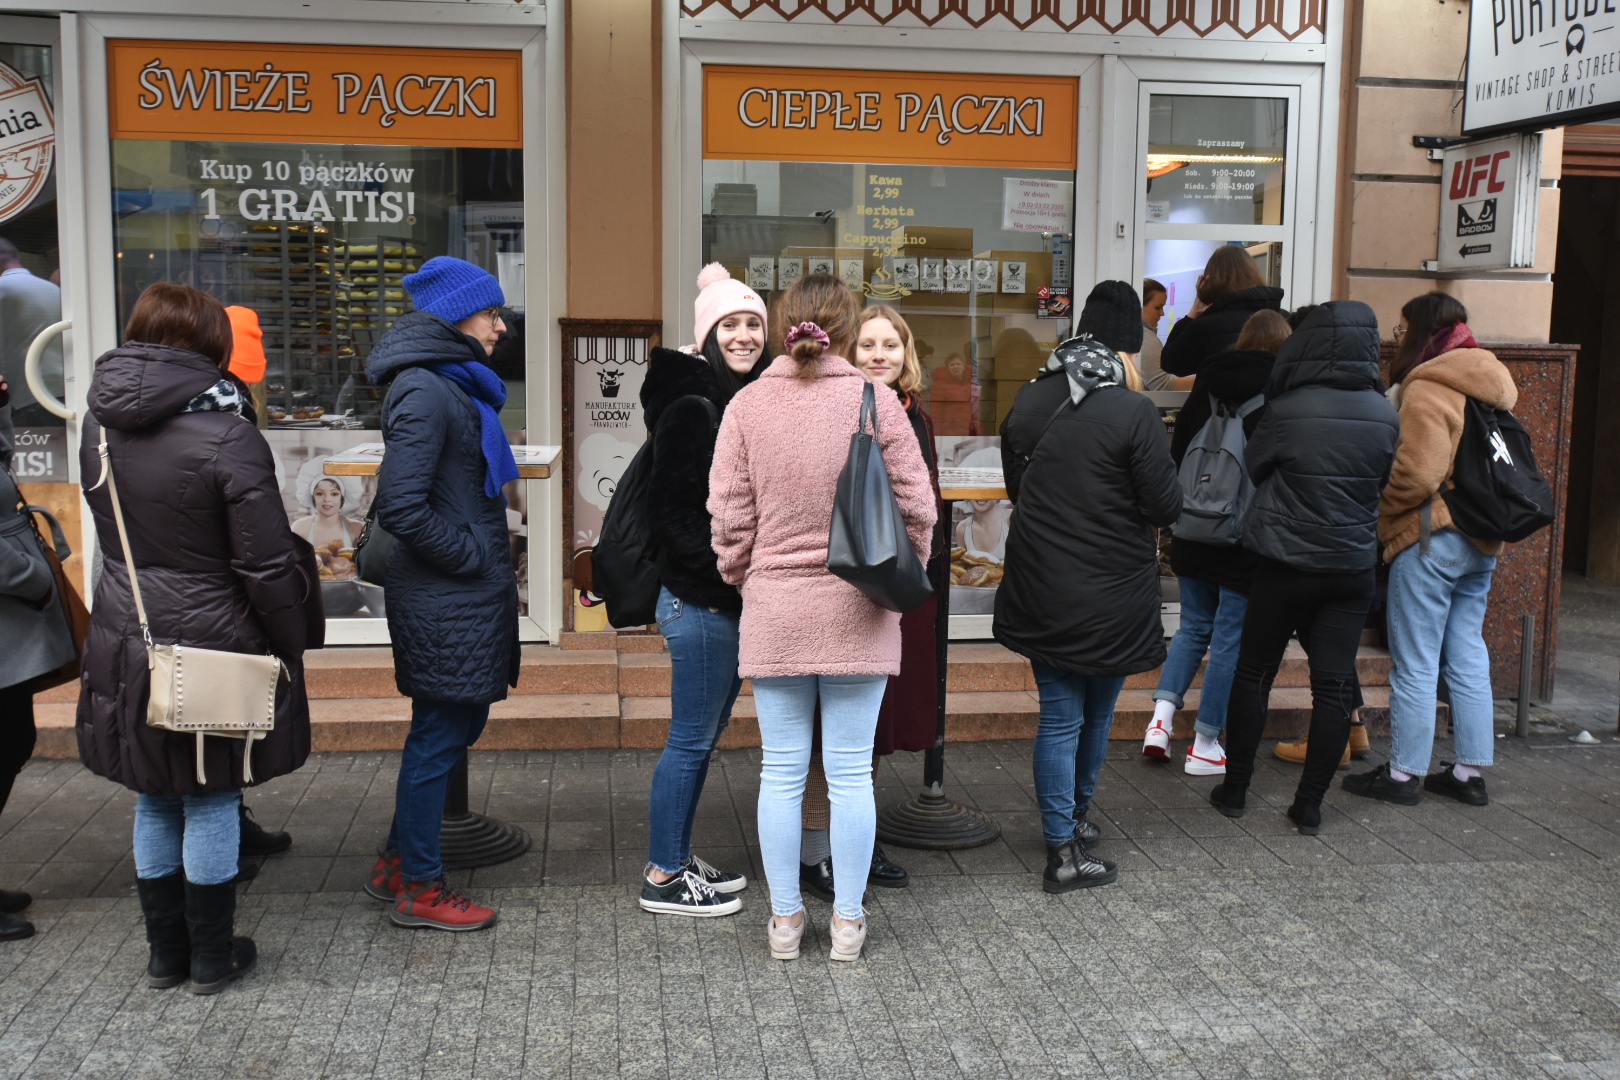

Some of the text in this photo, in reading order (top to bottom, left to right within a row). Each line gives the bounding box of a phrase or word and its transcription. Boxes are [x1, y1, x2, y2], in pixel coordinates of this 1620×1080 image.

[1476, 75, 1520, 102] VINTAGE
[1526, 67, 1555, 91] SHOP
[1561, 63, 1569, 83] &
[139, 58, 497, 129] ŚWIEŻE PĄCZKI
[1546, 83, 1596, 112] KOMIS
[737, 86, 1045, 146] CIEPŁE PĄCZKI
[1197, 139, 1245, 149] Zapraszamy
[200, 159, 253, 184] Kup
[262, 160, 290, 181] 10
[298, 162, 415, 187] pączków
[1211, 169, 1255, 178] 9:00-20:00
[1449, 151, 1511, 200] UFC
[869, 175, 903, 186] Kawa
[1020, 180, 1039, 188] Drodzy
[1211, 182, 1255, 191] 9:00-19:00
[873, 187, 900, 199] 2,99
[1031, 191, 1050, 199] dniach
[200, 188, 417, 226] 1 GRATIS!
[856, 204, 915, 217] Herbata
[1010, 208, 1036, 216] Promocja
[872, 218, 899, 230] 2,99
[843, 233, 927, 247] Cappuccino
[872, 246, 898, 259] 2,99
[585, 402, 637, 410] MANUFAKTURA
[591, 410, 631, 421] LODÓW
